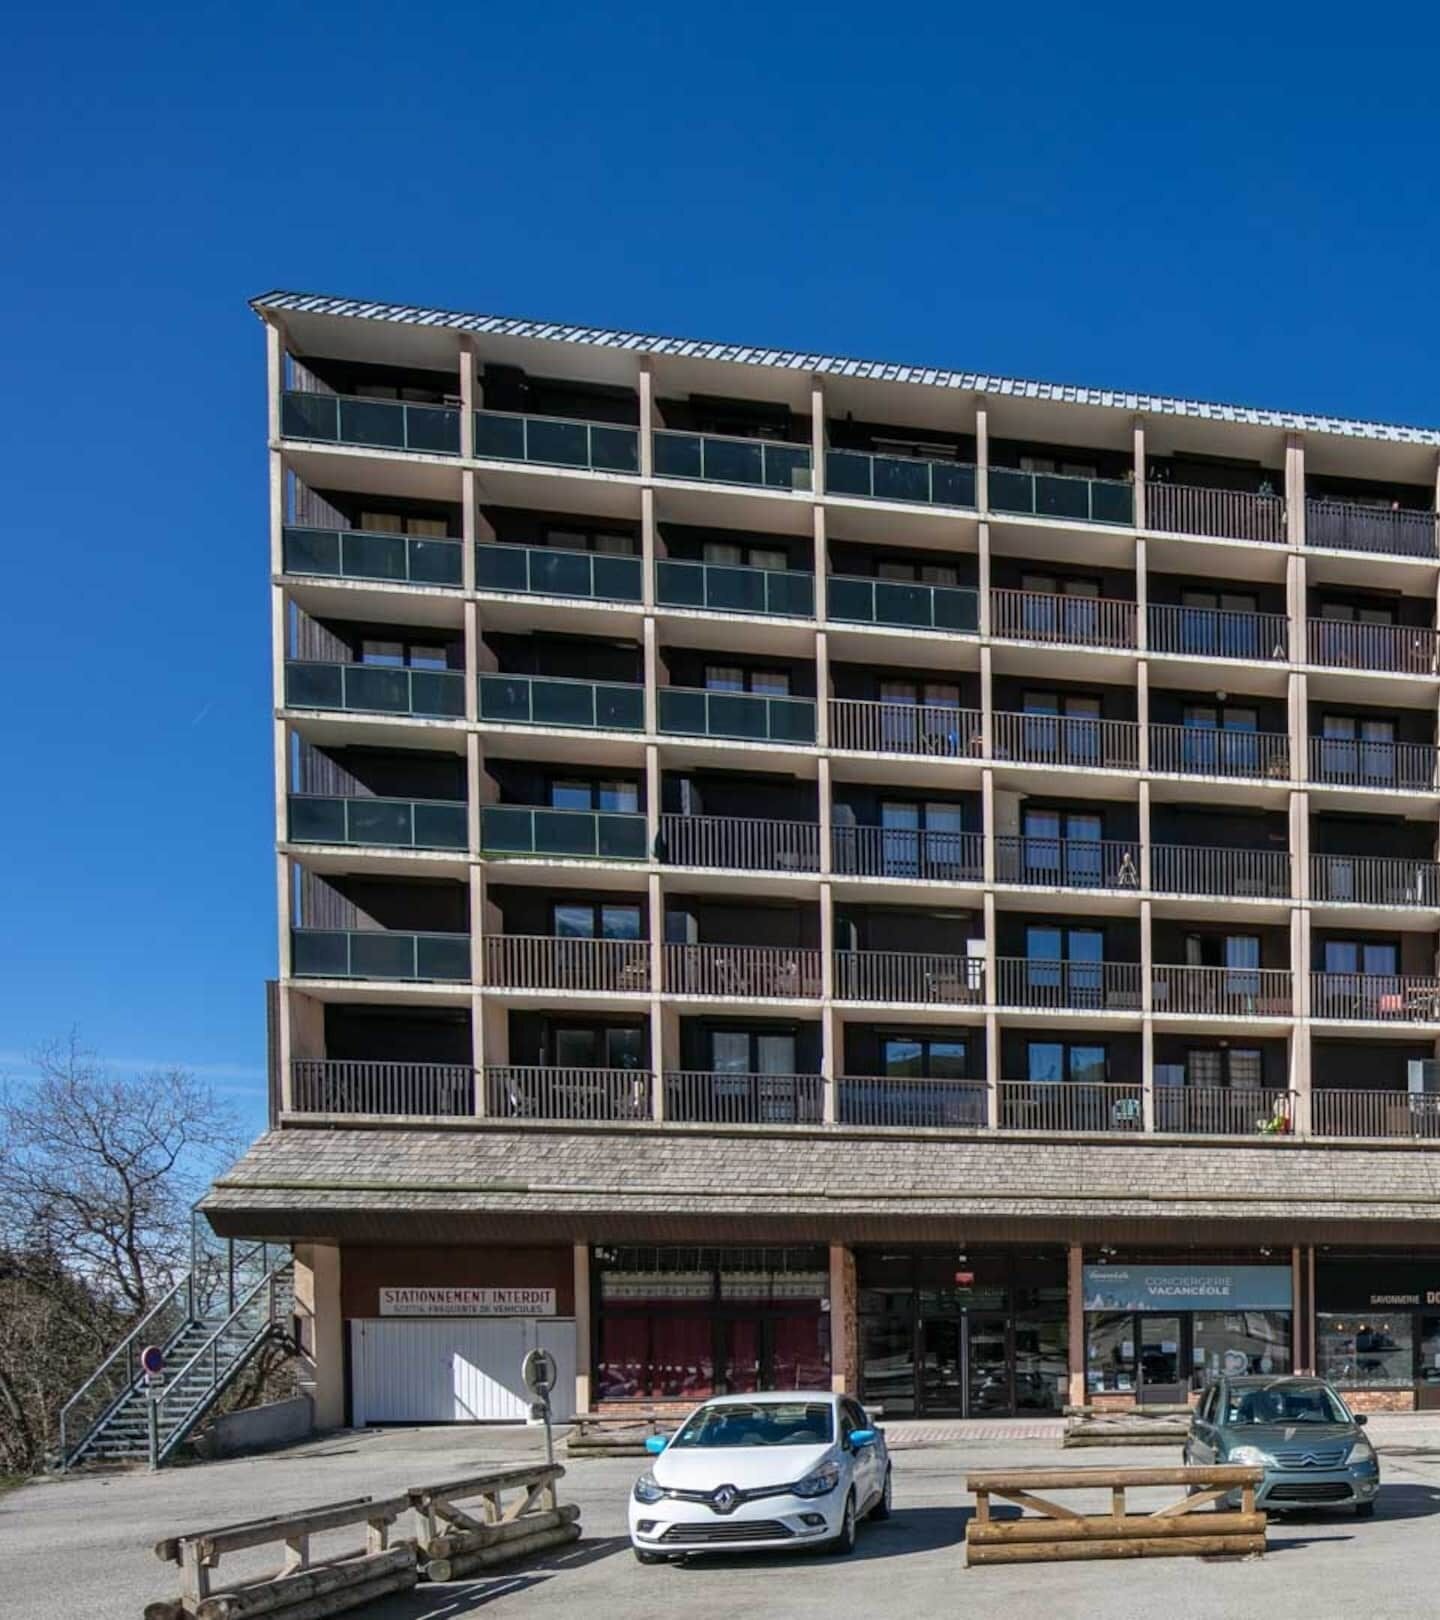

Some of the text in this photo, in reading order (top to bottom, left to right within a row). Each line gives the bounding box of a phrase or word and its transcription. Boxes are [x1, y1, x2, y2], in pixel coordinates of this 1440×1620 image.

[1145, 1276, 1232, 1287] CONCIERGERIE
[385, 1290, 551, 1304] STATIONNEMENT INTERDIT
